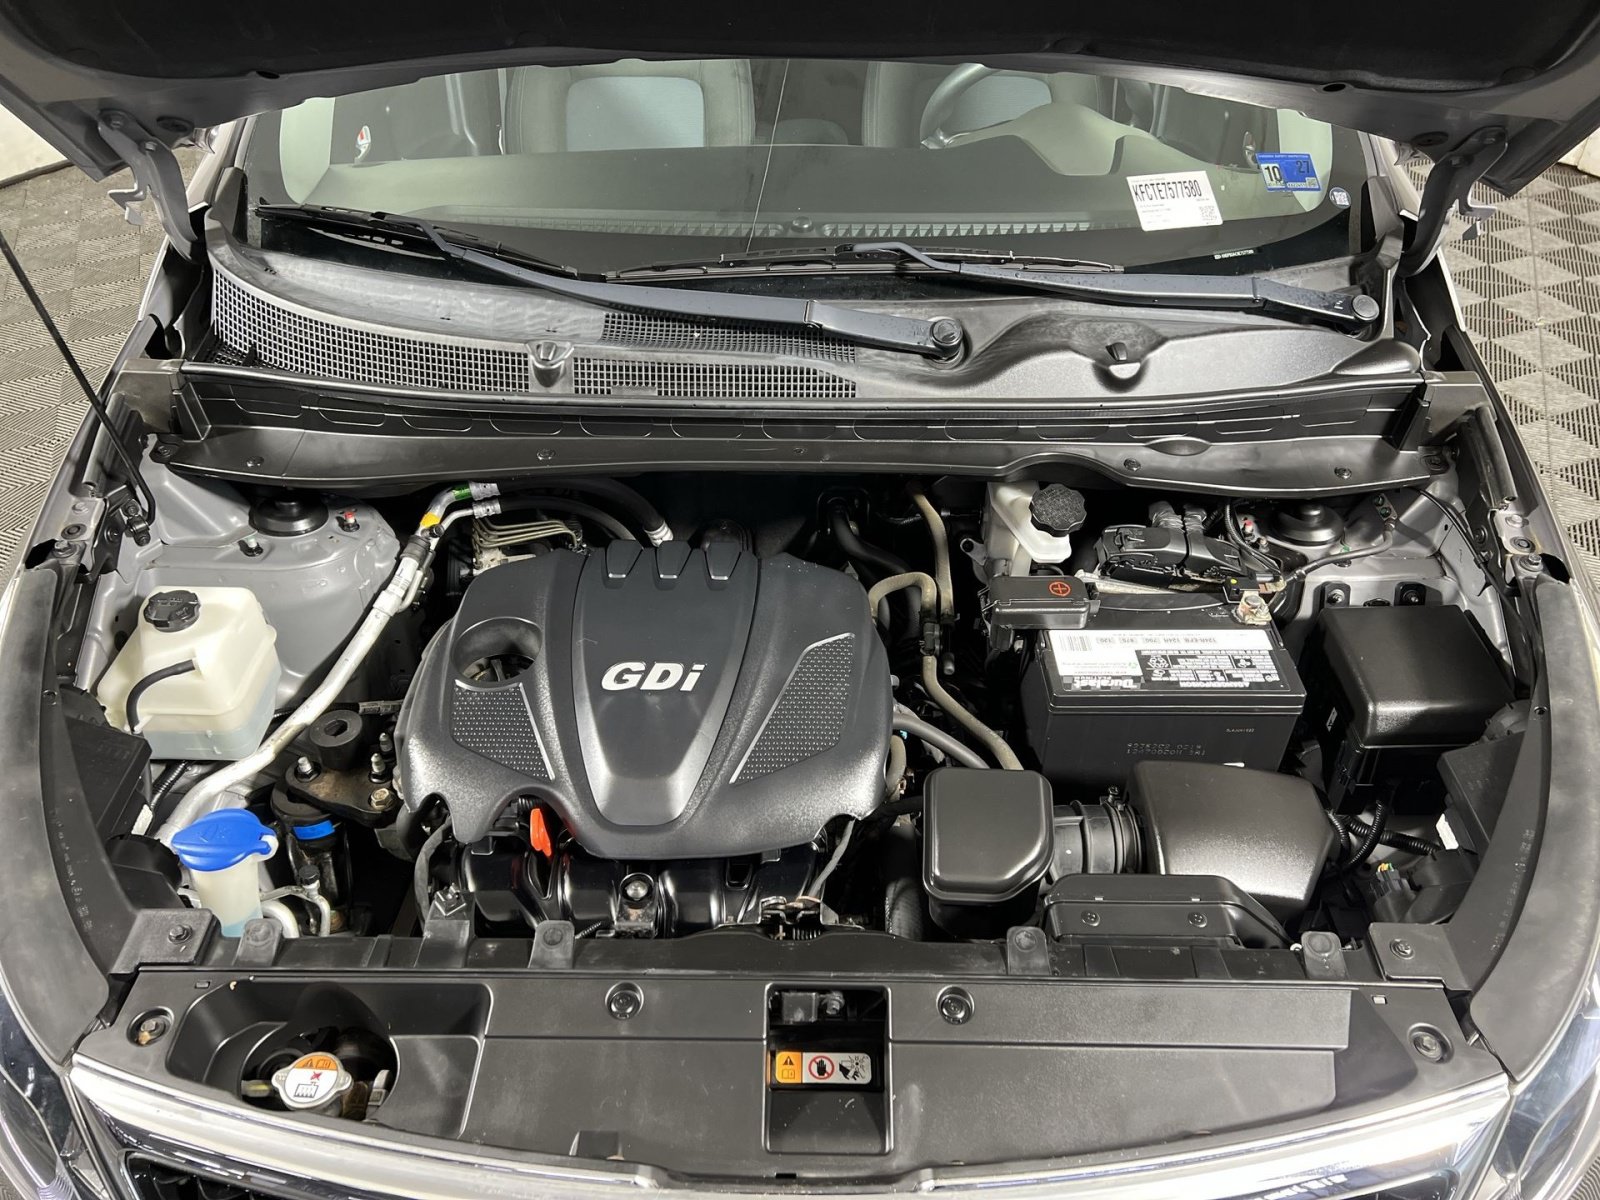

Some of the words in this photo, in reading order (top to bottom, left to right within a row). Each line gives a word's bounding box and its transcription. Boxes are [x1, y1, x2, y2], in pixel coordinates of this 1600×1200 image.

[1264, 165, 1283, 183] 10
[1296, 160, 1310, 174] 27
[1131, 179, 1202, 202] KFCTE7577580
[601, 661, 706, 691] GDi
[1073, 676, 1137, 689] Duralast
